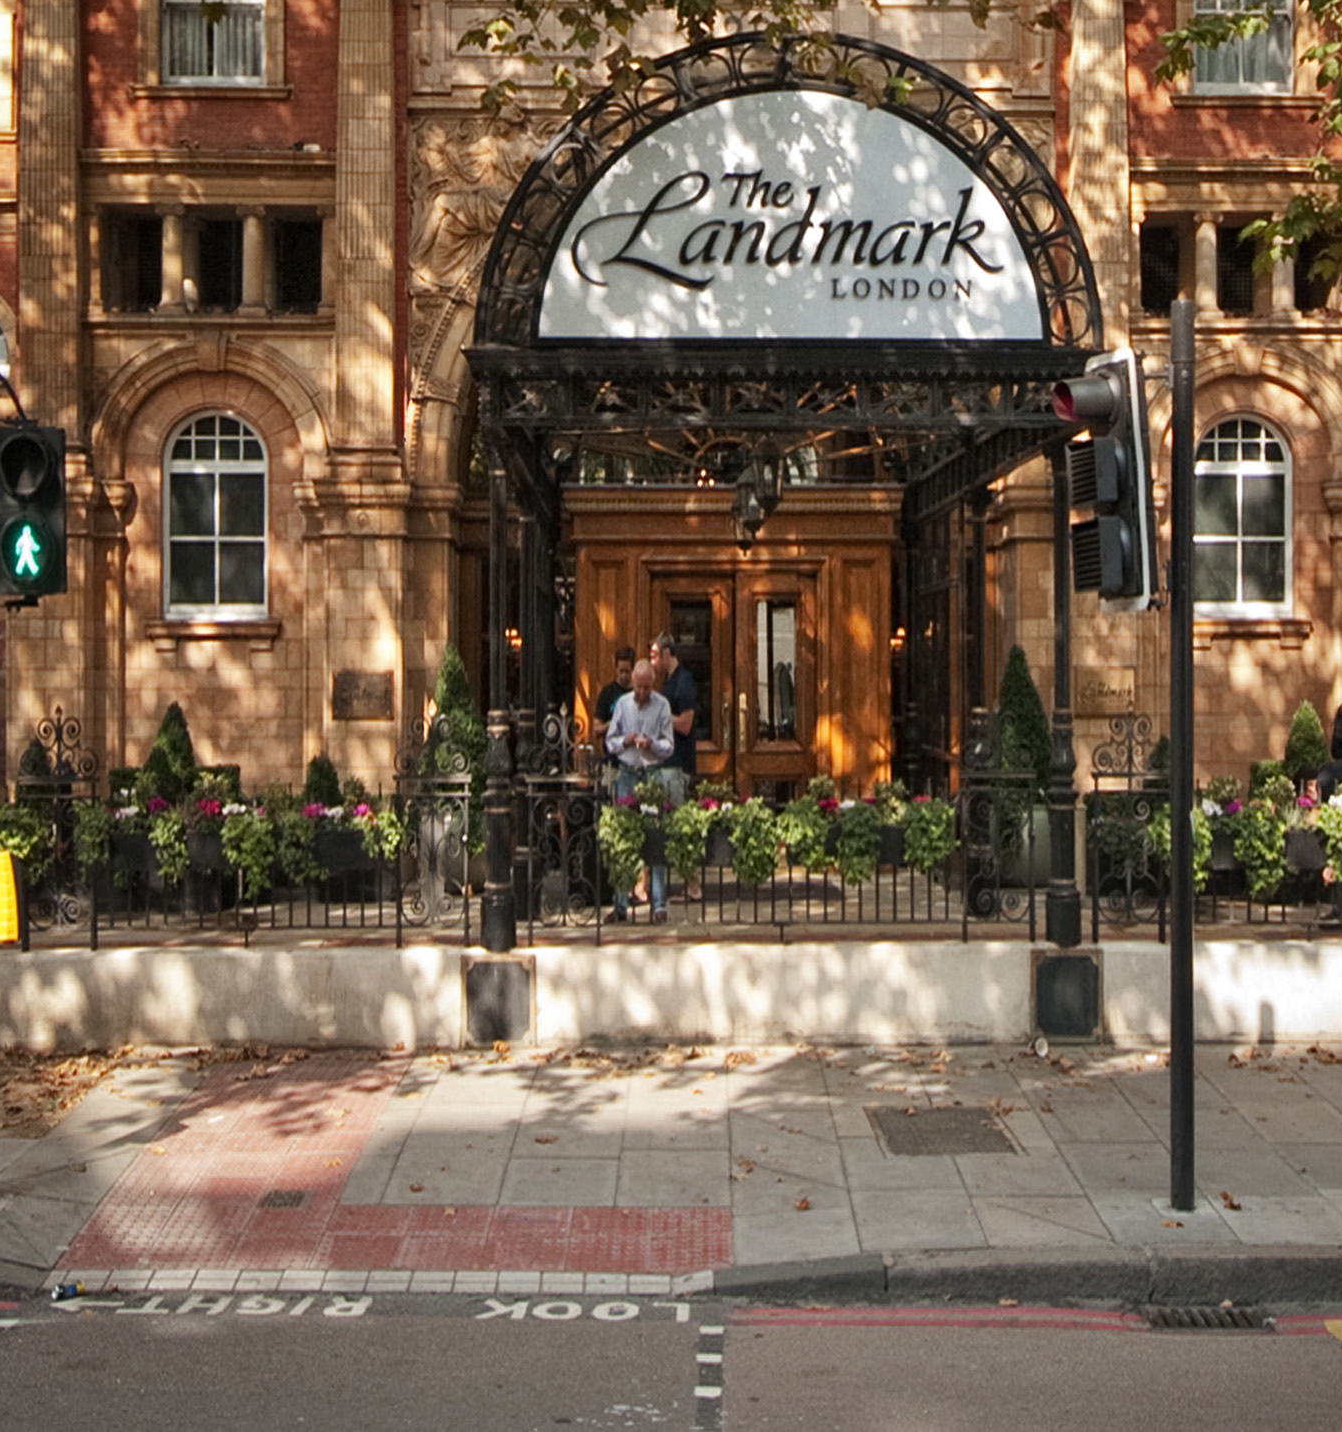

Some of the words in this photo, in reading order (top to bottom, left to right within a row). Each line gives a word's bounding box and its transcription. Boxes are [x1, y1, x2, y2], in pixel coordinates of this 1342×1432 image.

[721, 169, 794, 210] The
[571, 170, 1005, 291] Landmark
[831, 277, 974, 302] LONDON
[116, 1294, 371, 1318] RIGHT
[475, 1299, 690, 1323] LOOK
